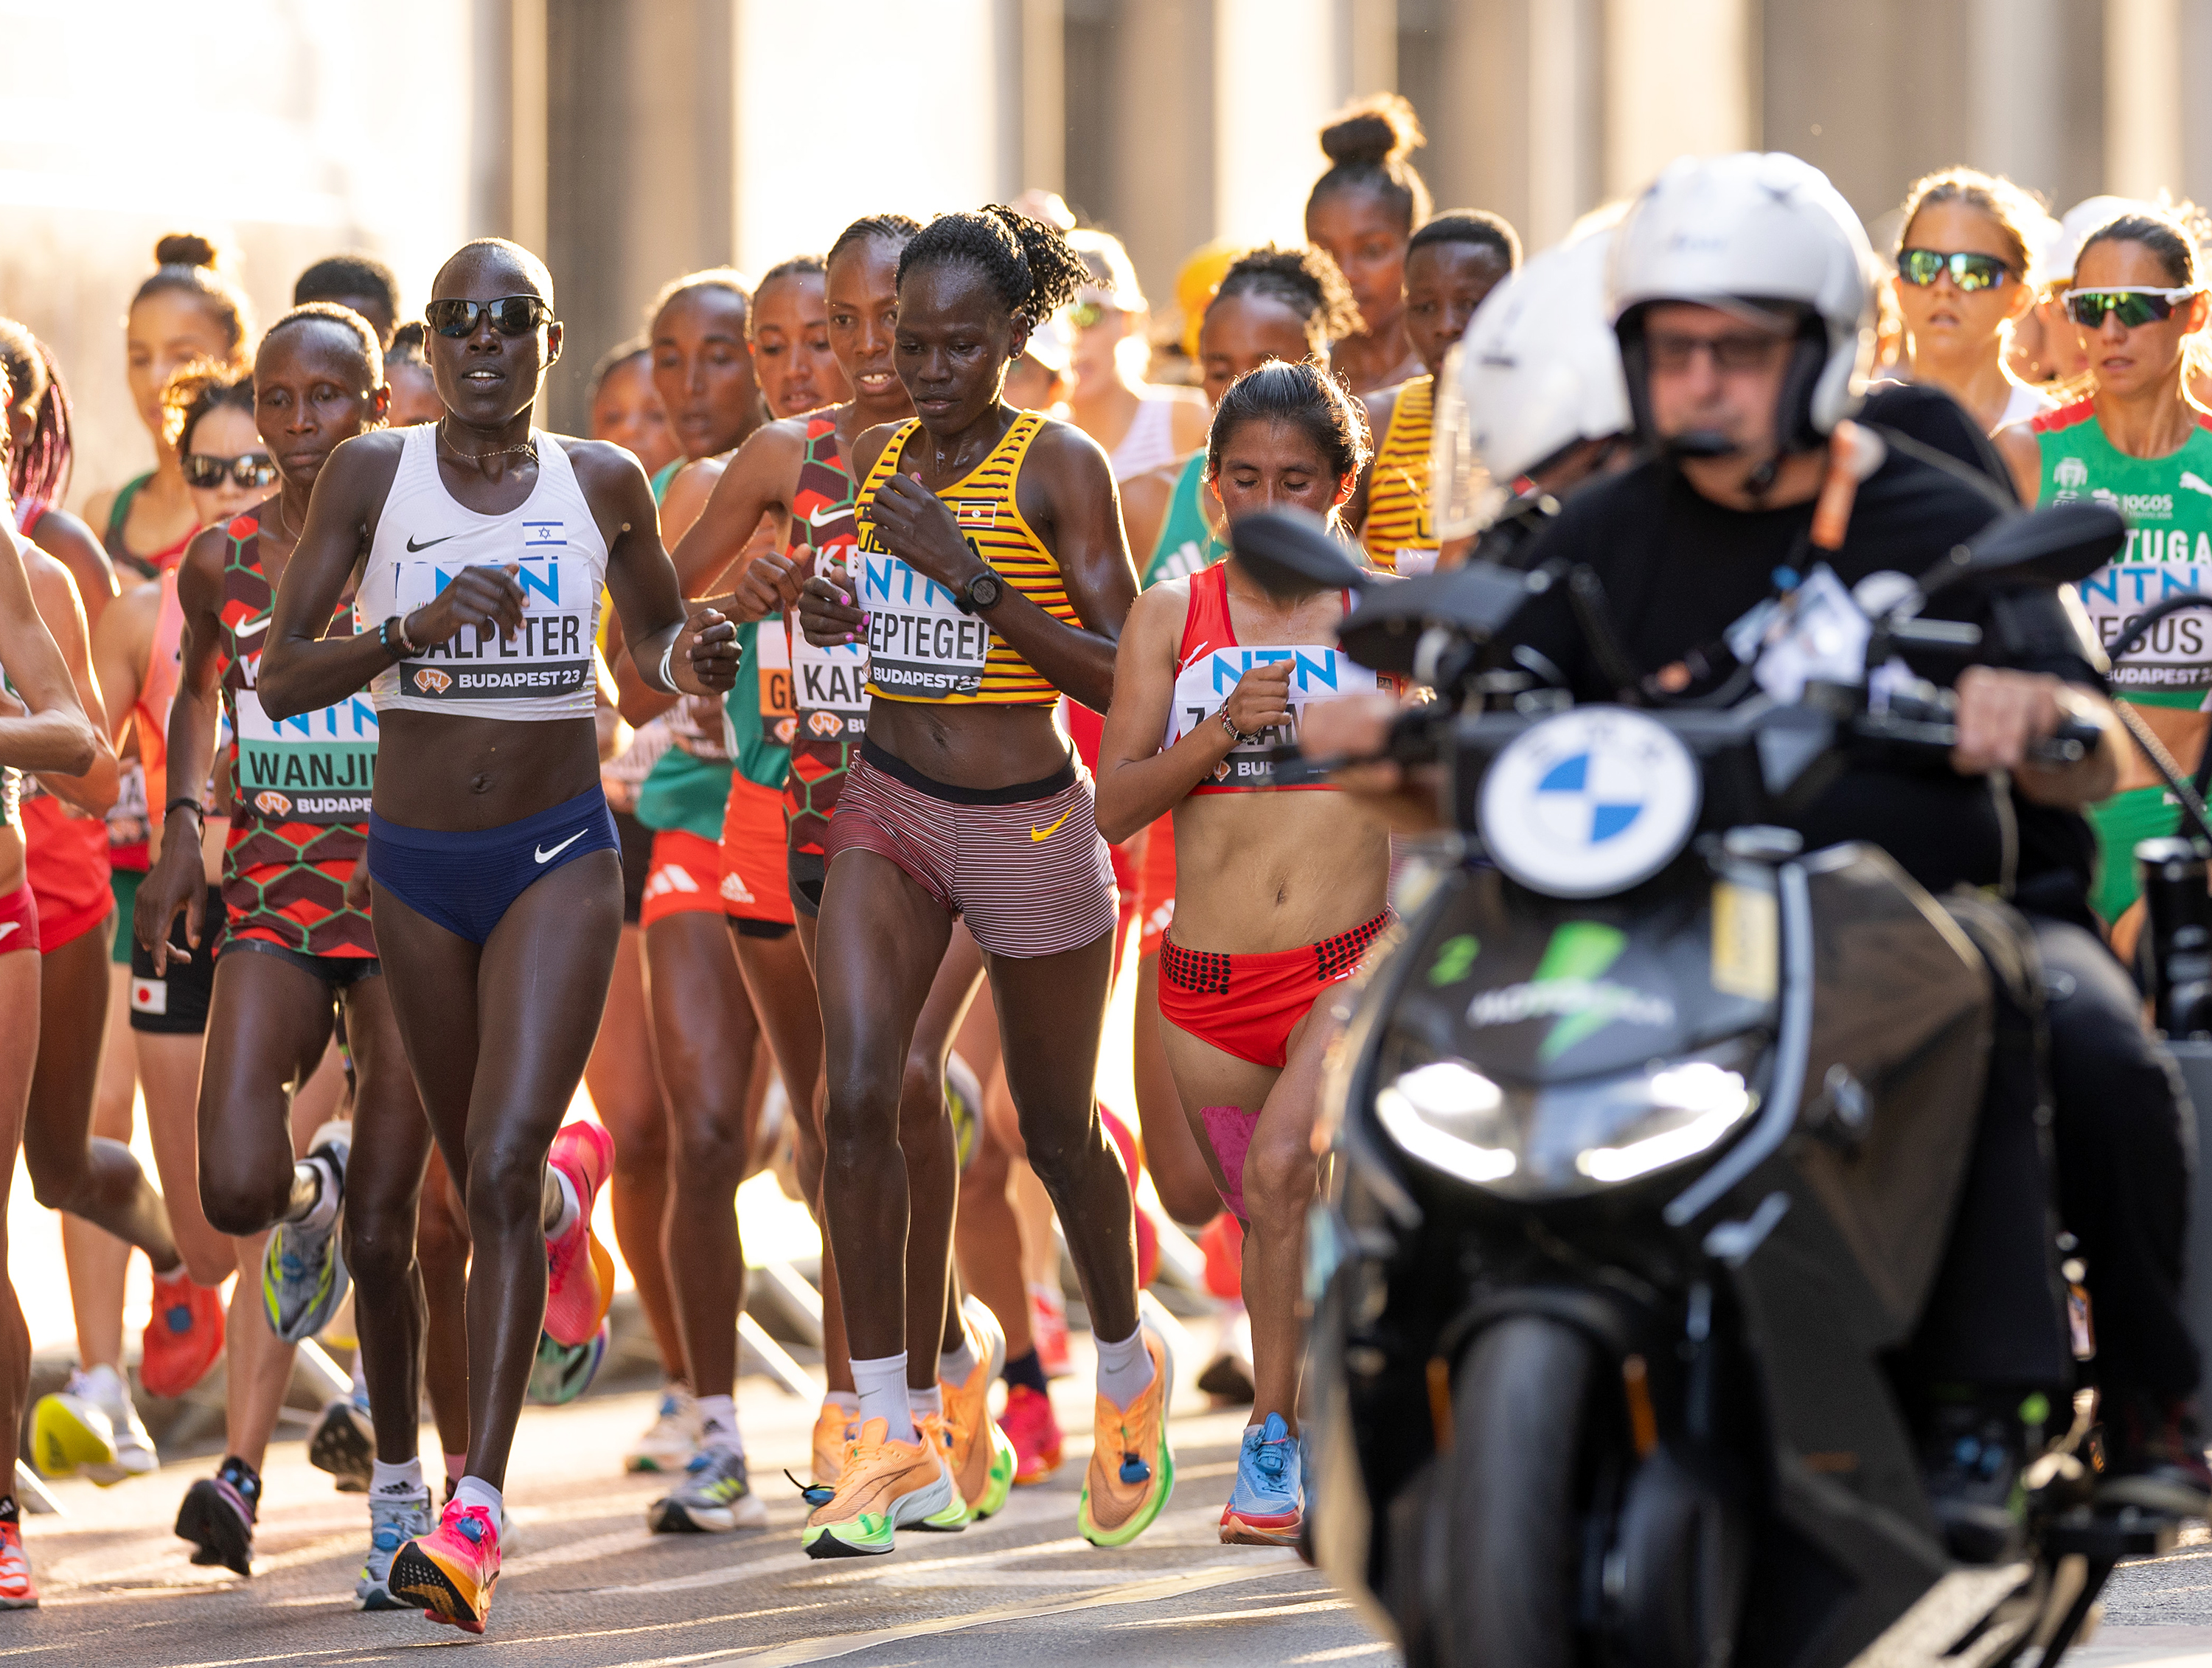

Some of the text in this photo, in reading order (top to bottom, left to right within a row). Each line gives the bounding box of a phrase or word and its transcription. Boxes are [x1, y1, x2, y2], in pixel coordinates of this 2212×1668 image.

[2112, 528, 2212, 565] TUGA
[410, 615, 580, 658] ALPETER
[869, 611, 985, 661] EPTEGEI
[2090, 614, 2202, 655] ESUS
[459, 670, 581, 689] BUDAPEST 23
[874, 667, 959, 689] BUDAPEST
[248, 751, 378, 787] WANJI
